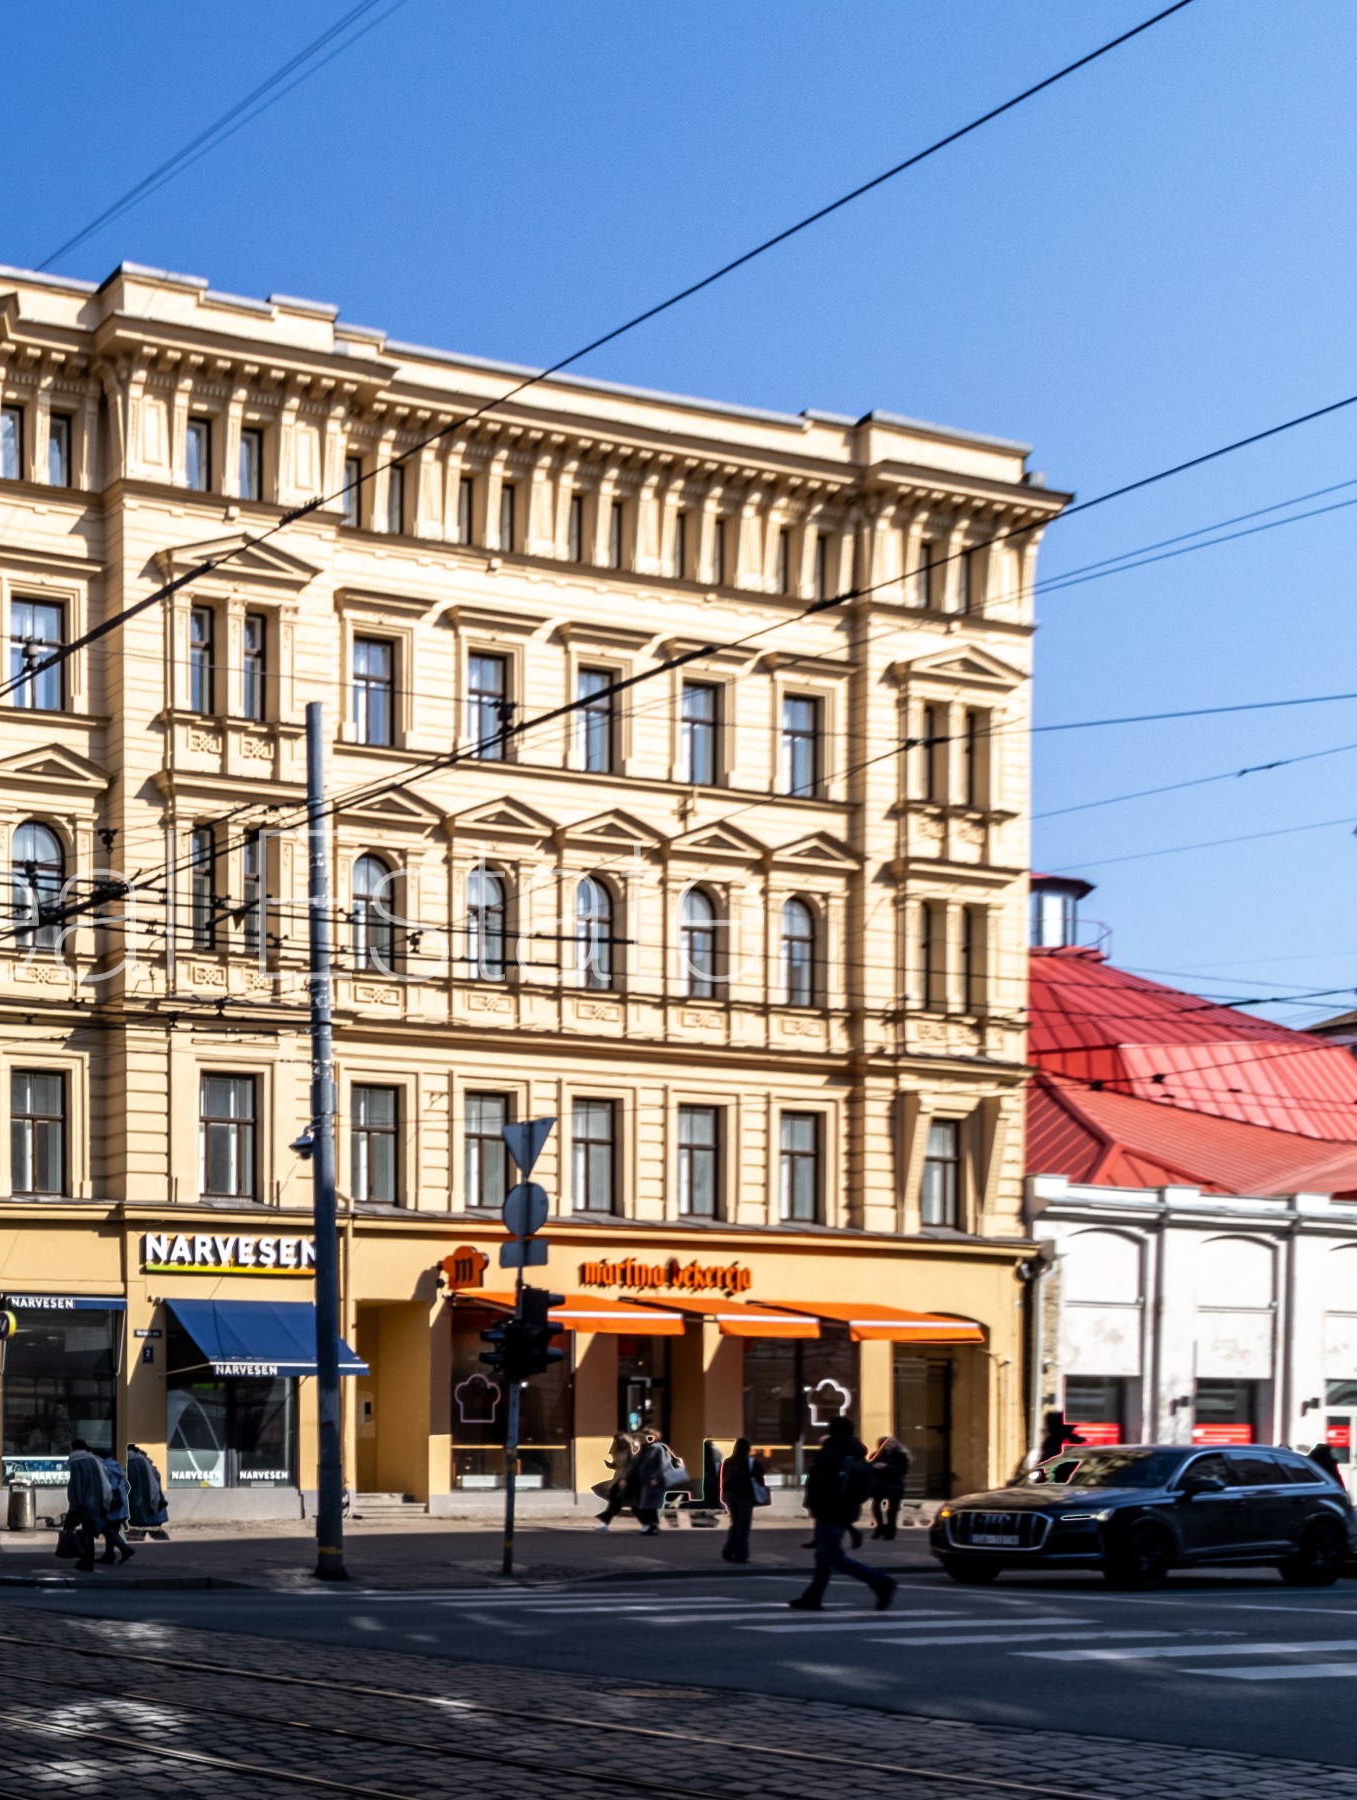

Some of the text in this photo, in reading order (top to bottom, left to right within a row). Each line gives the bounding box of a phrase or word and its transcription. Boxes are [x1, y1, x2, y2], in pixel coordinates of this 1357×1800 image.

[145, 1232, 316, 1266] NARVESEN
[11, 1297, 74, 1310] NARVESEN
[216, 1364, 278, 1376] NARVESEN
[31, 1471, 71, 1481] NARVES
[171, 1470, 222, 1480] NARVESEN
[239, 1470, 289, 1480] NARVESEN
